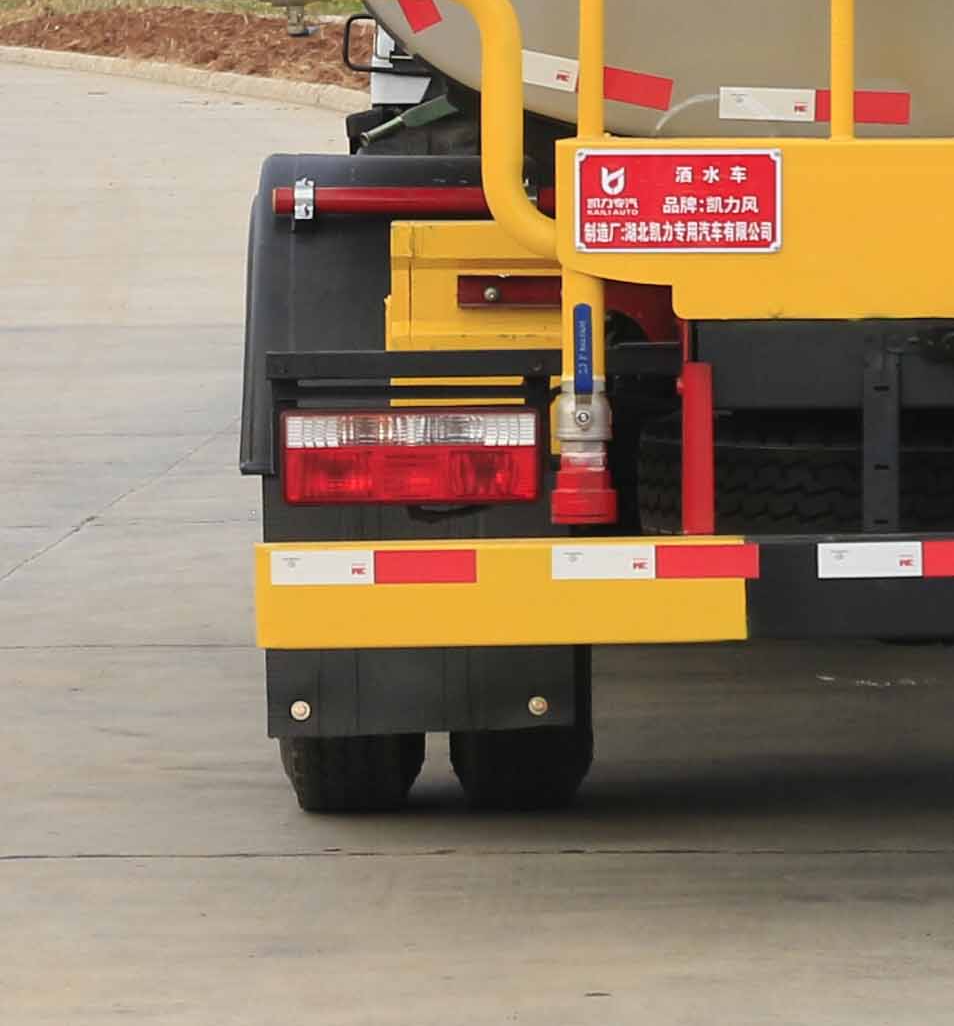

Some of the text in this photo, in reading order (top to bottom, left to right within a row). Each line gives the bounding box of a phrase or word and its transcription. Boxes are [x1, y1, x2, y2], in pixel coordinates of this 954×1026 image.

[632, 561, 648, 570] 3M
[900, 559, 914, 568] 3M
[351, 567, 367, 576] 3M
